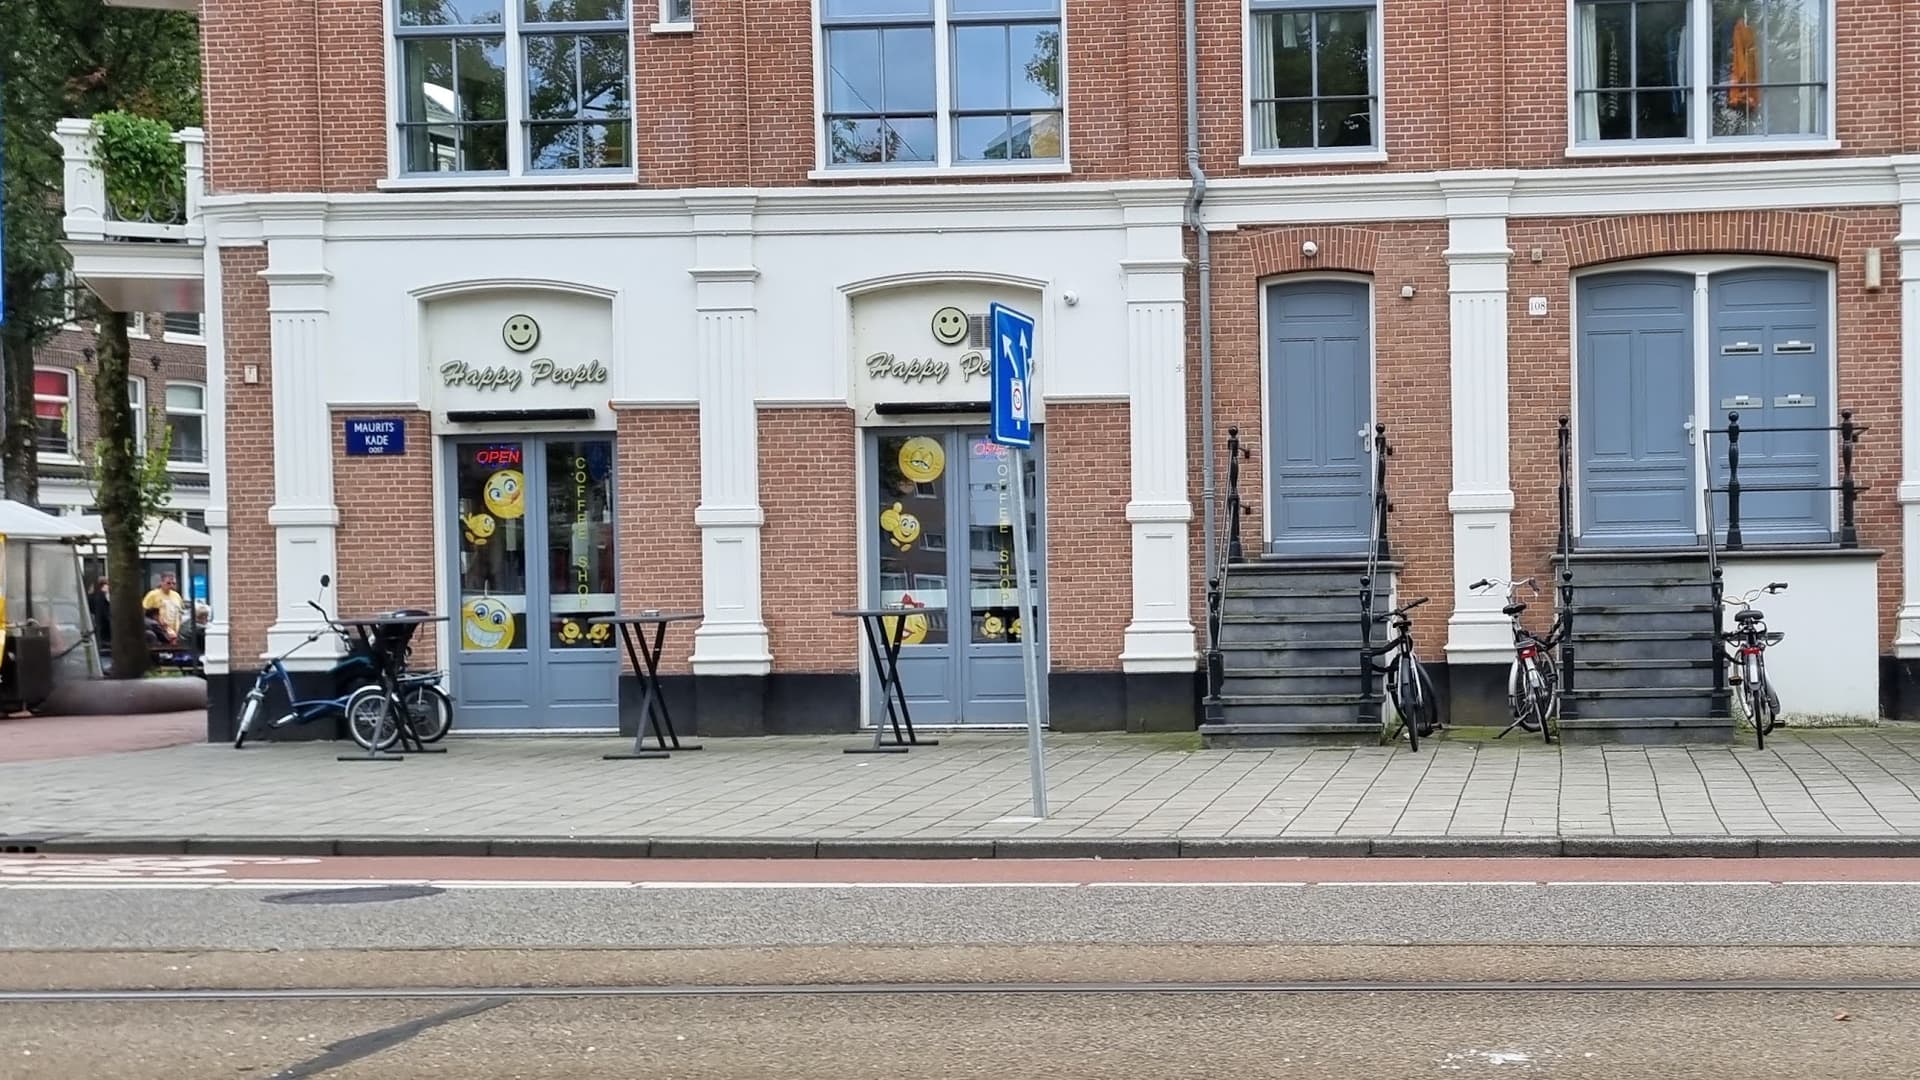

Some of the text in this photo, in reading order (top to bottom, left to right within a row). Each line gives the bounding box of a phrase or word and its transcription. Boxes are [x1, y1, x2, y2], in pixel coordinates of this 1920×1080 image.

[440, 358, 606, 391] Happy People
[866, 352, 949, 383] Happy
[353, 422, 395, 433] MAURITS
[364, 434, 389, 446] KADE
[368, 446, 384, 454] OOST
[476, 450, 519, 463] OPEN
[575, 457, 589, 609] COFFEE SHOP
[1000, 550, 1010, 604] SHOP
